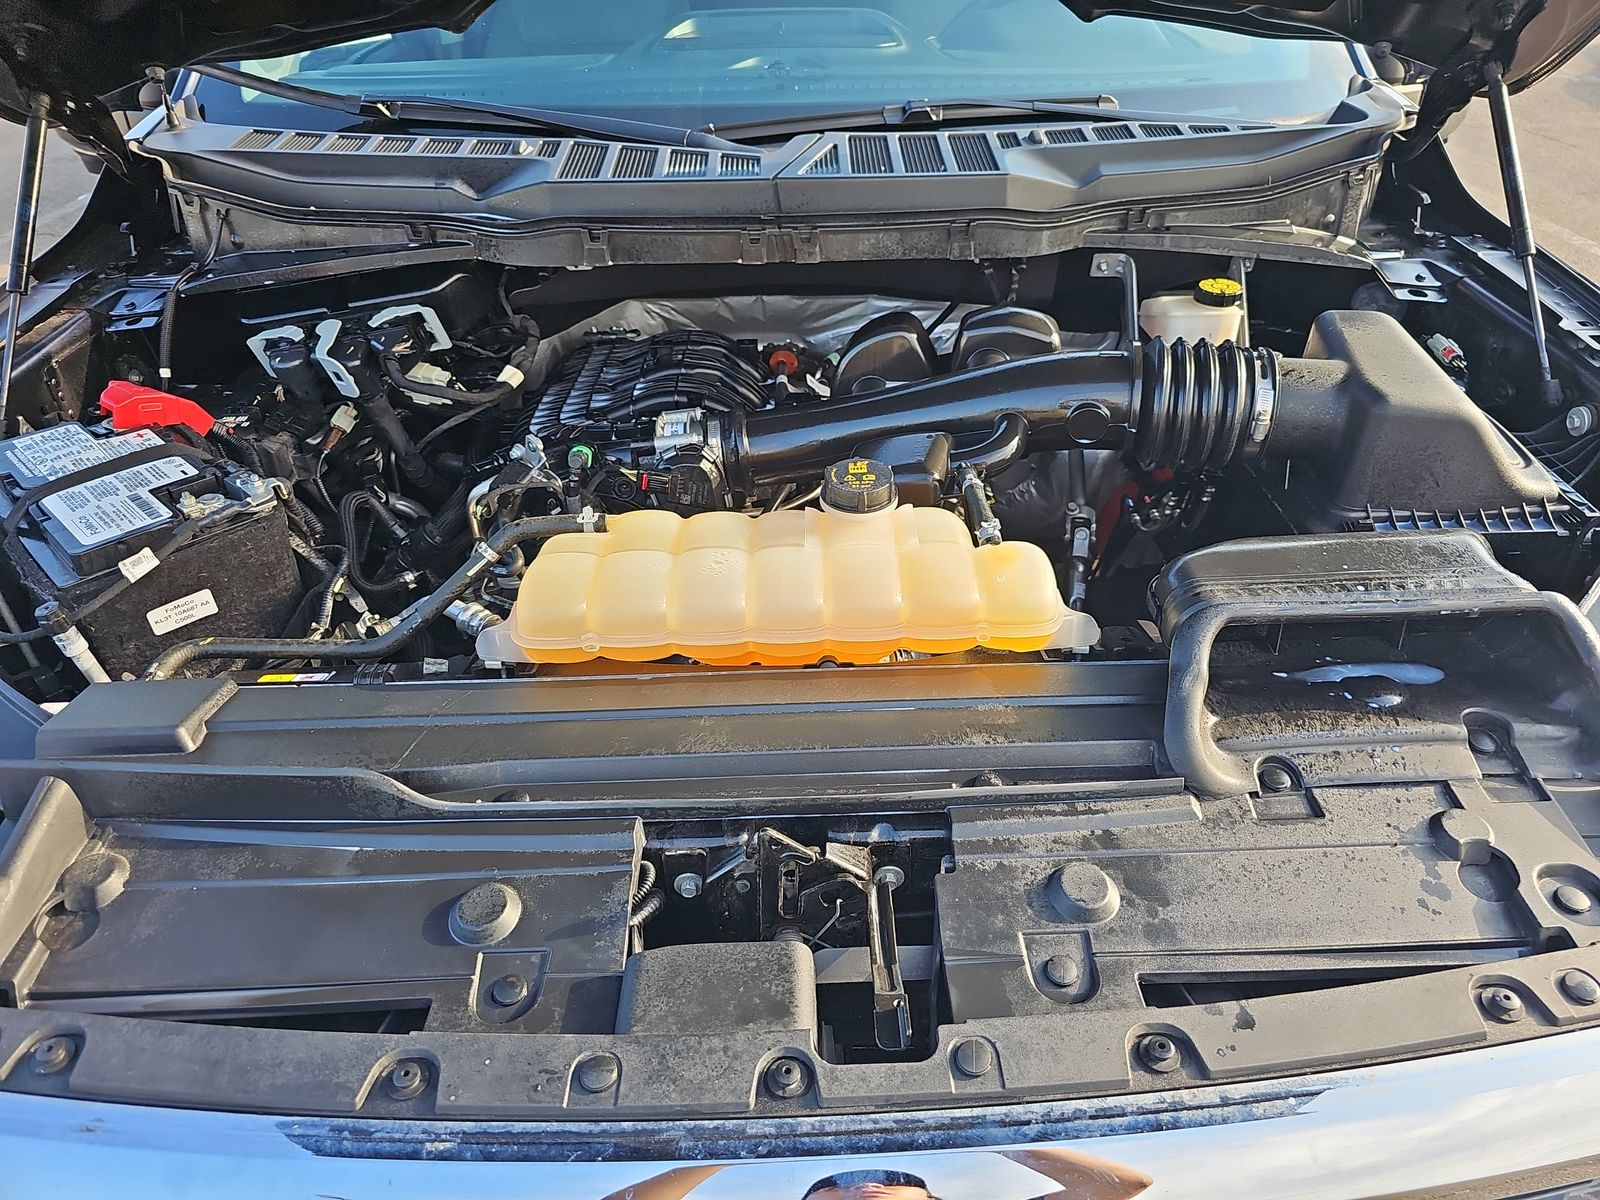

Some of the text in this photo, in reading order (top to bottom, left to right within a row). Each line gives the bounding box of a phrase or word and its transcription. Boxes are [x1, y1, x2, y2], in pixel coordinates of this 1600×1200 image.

[165, 600, 195, 613] FoMoCo
[154, 614, 173, 625] KL3T
[174, 614, 197, 624] C500L
